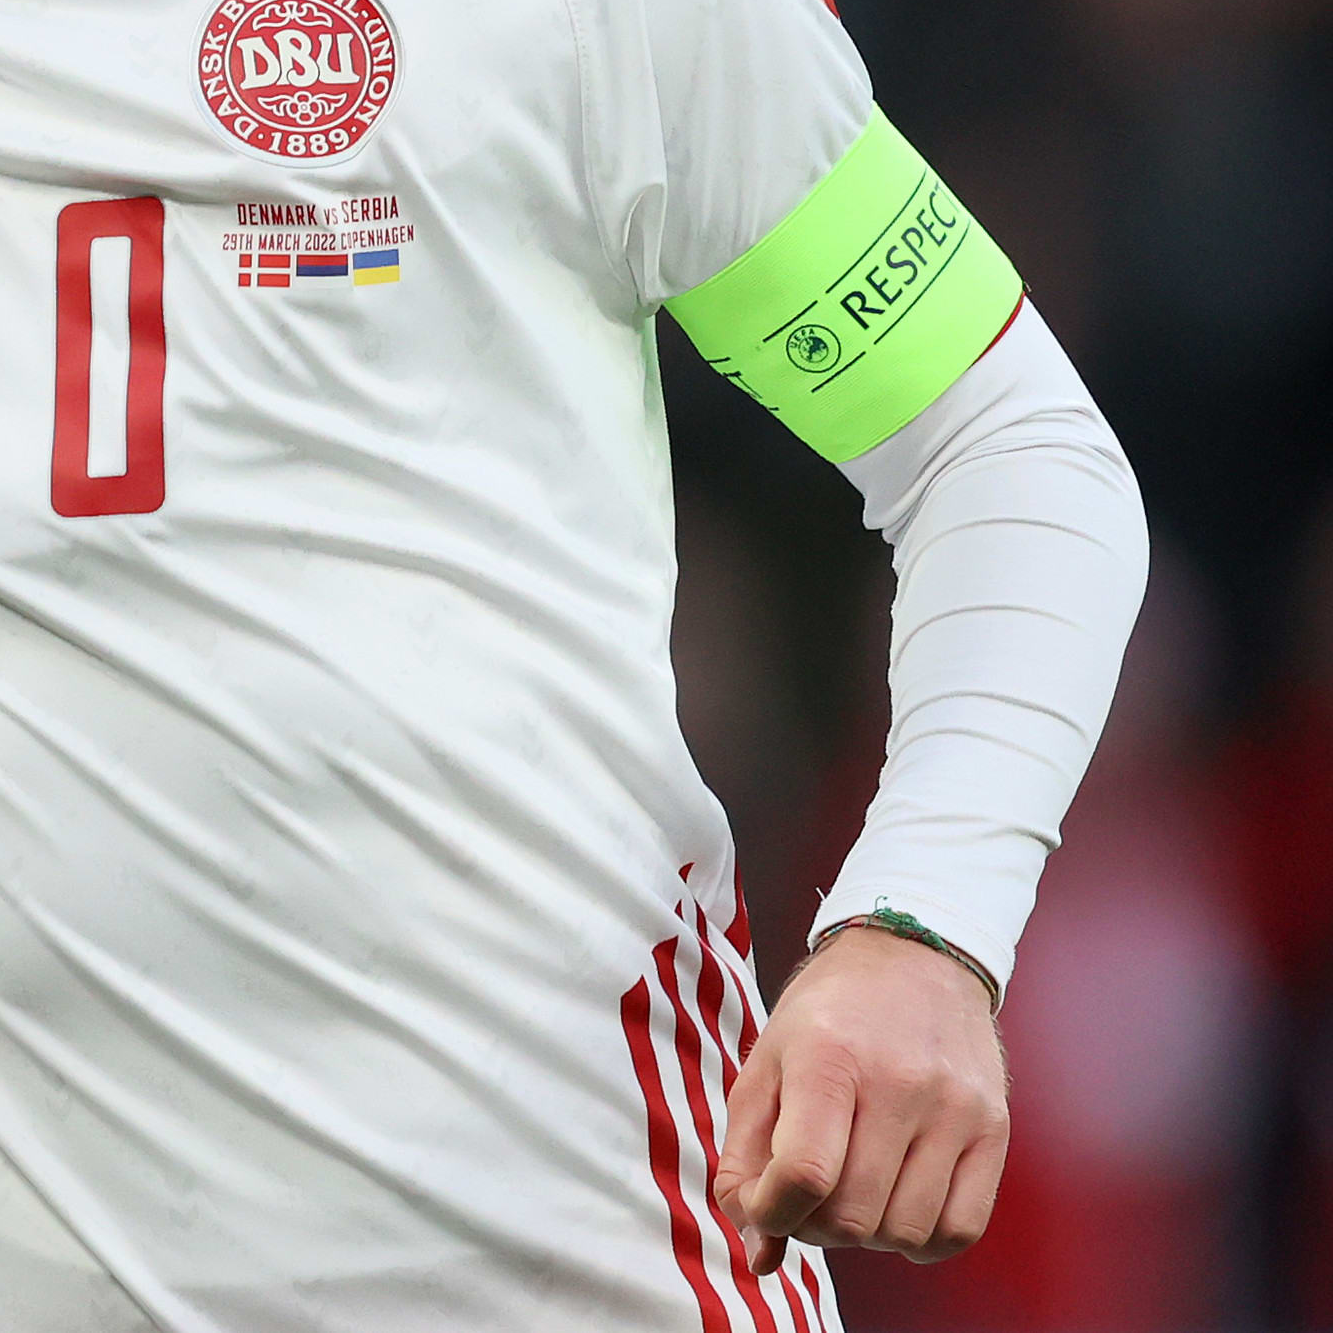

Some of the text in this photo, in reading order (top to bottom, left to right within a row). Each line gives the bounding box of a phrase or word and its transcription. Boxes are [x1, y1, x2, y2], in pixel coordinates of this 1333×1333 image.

[236, 28, 360, 90] DBU
[201, 30, 259, 141] DANSK
[269, 130, 351, 156] 1889
[237, 202, 318, 227] DENMARK
[341, 195, 399, 224] SERBIA
[222, 224, 414, 251] 29TH MARCH 2022 COPENHAGEN
[789, 328, 815, 349] UEFA
